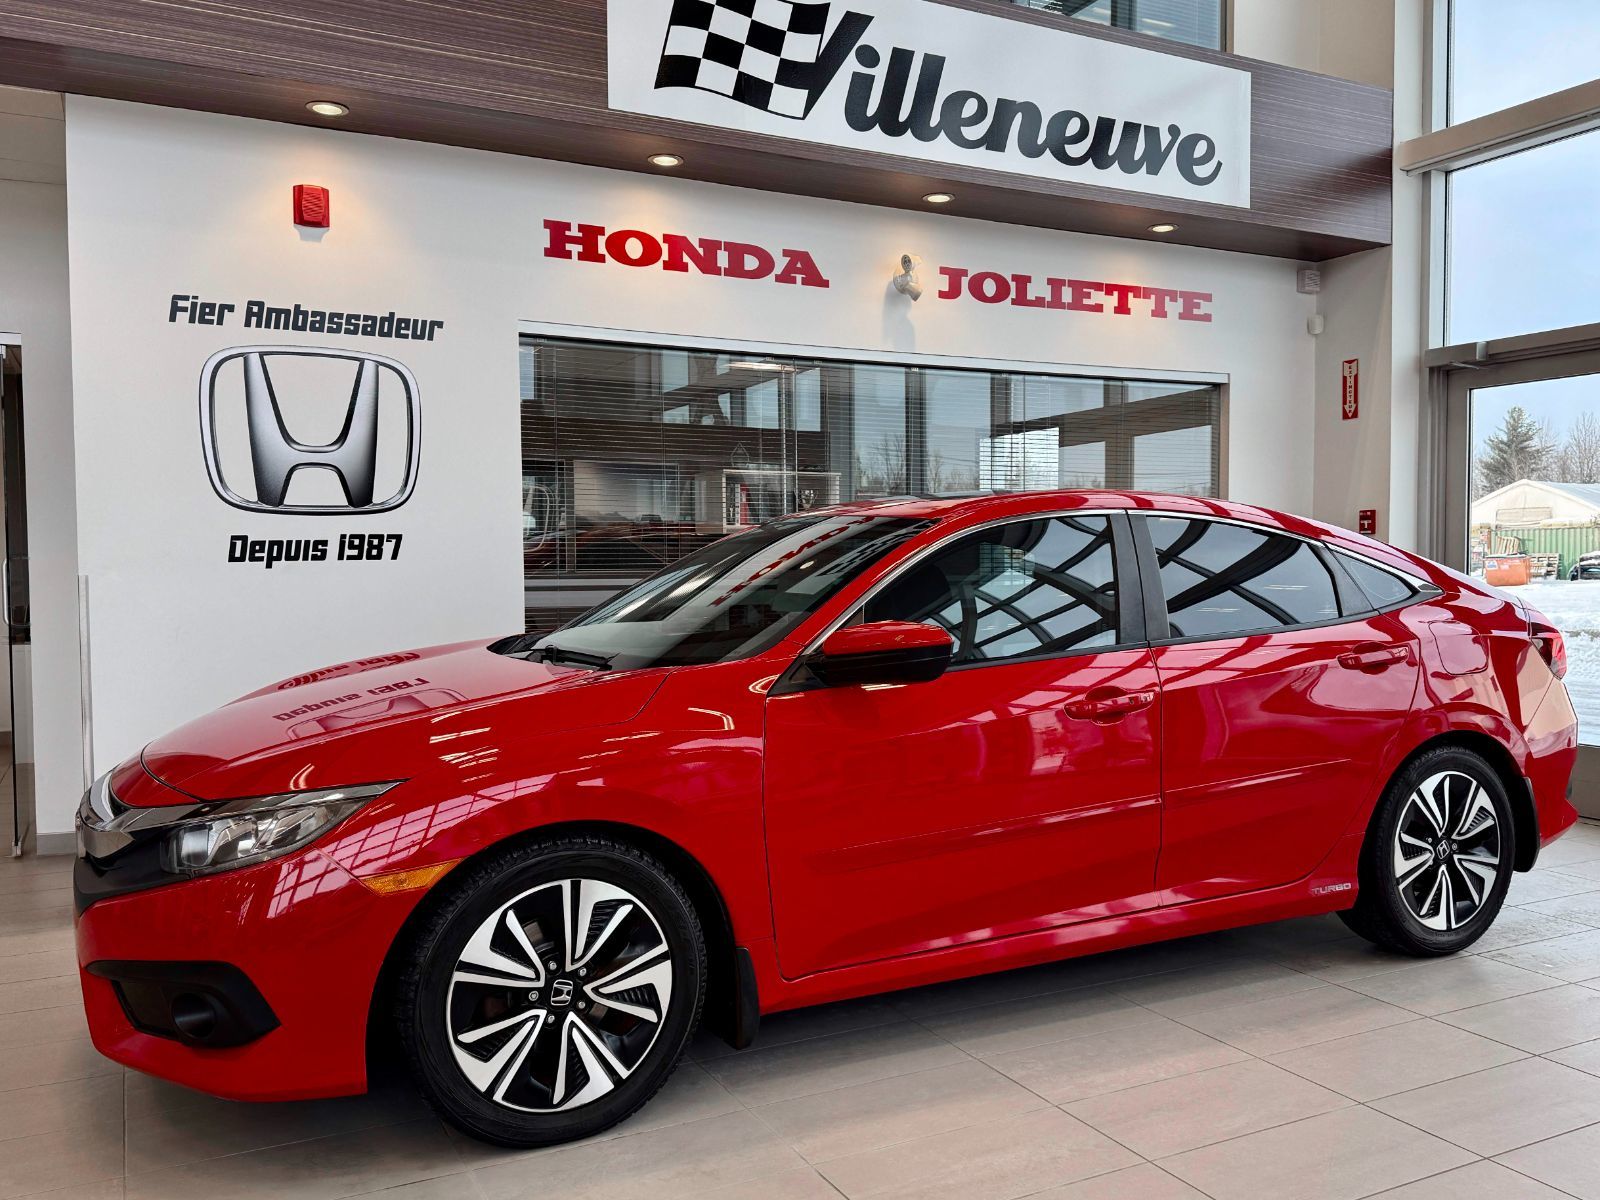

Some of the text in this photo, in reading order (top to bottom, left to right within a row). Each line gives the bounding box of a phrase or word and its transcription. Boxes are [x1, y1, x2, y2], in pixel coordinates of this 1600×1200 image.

[795, 9, 1223, 187] Villeneuve
[543, 218, 1213, 323] HONDA JOLIETTE
[168, 294, 444, 342] Fier Ambassadeur
[228, 533, 403, 569] Depuis 1987
[1312, 882, 1351, 895] TURBO
